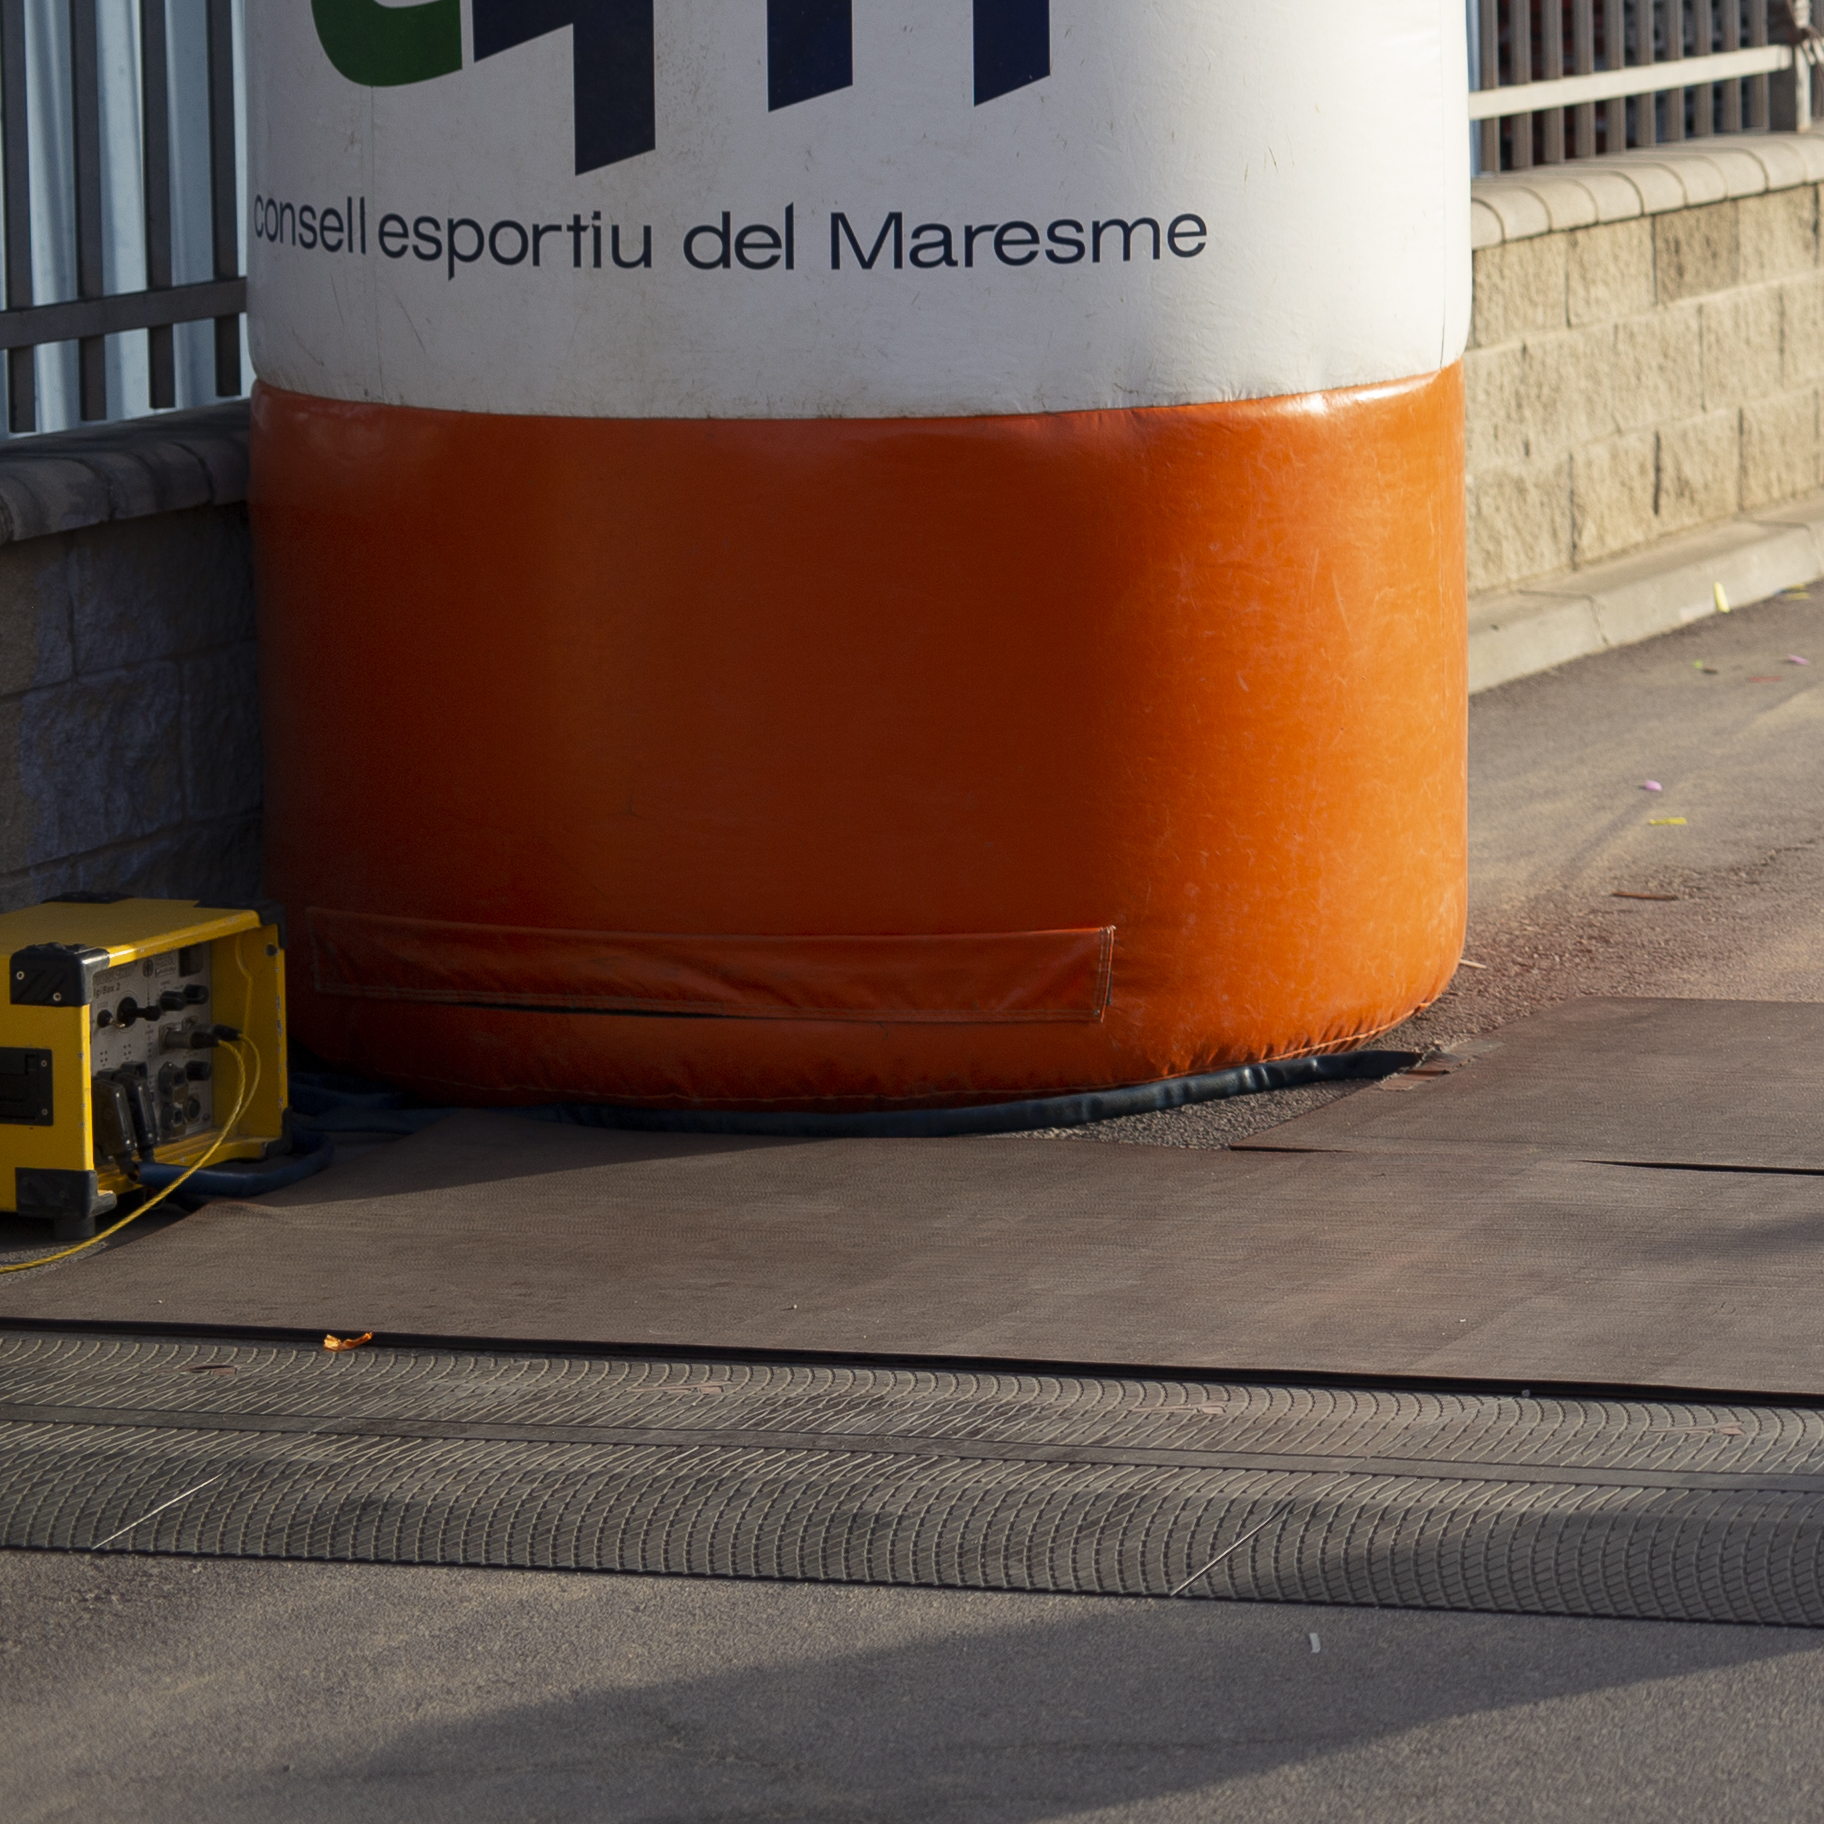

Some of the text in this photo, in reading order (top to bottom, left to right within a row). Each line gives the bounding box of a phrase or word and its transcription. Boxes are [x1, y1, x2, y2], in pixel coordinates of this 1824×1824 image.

[253, 194, 1207, 282] consell esportiu del Maresme
